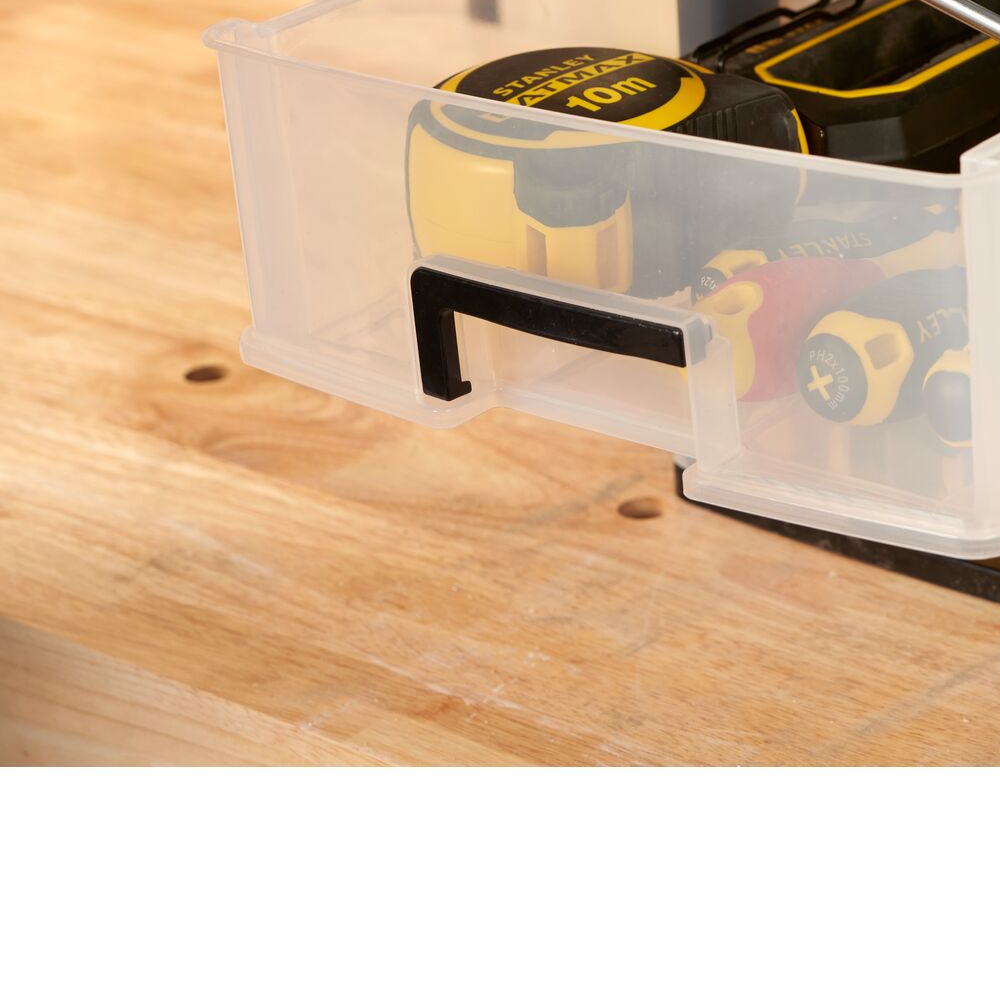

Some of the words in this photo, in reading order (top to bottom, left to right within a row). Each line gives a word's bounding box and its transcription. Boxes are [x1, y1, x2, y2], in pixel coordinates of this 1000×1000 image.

[492, 54, 595, 97] STANLEY
[515, 54, 648, 106] ATMAX
[566, 77, 657, 112] 10m
